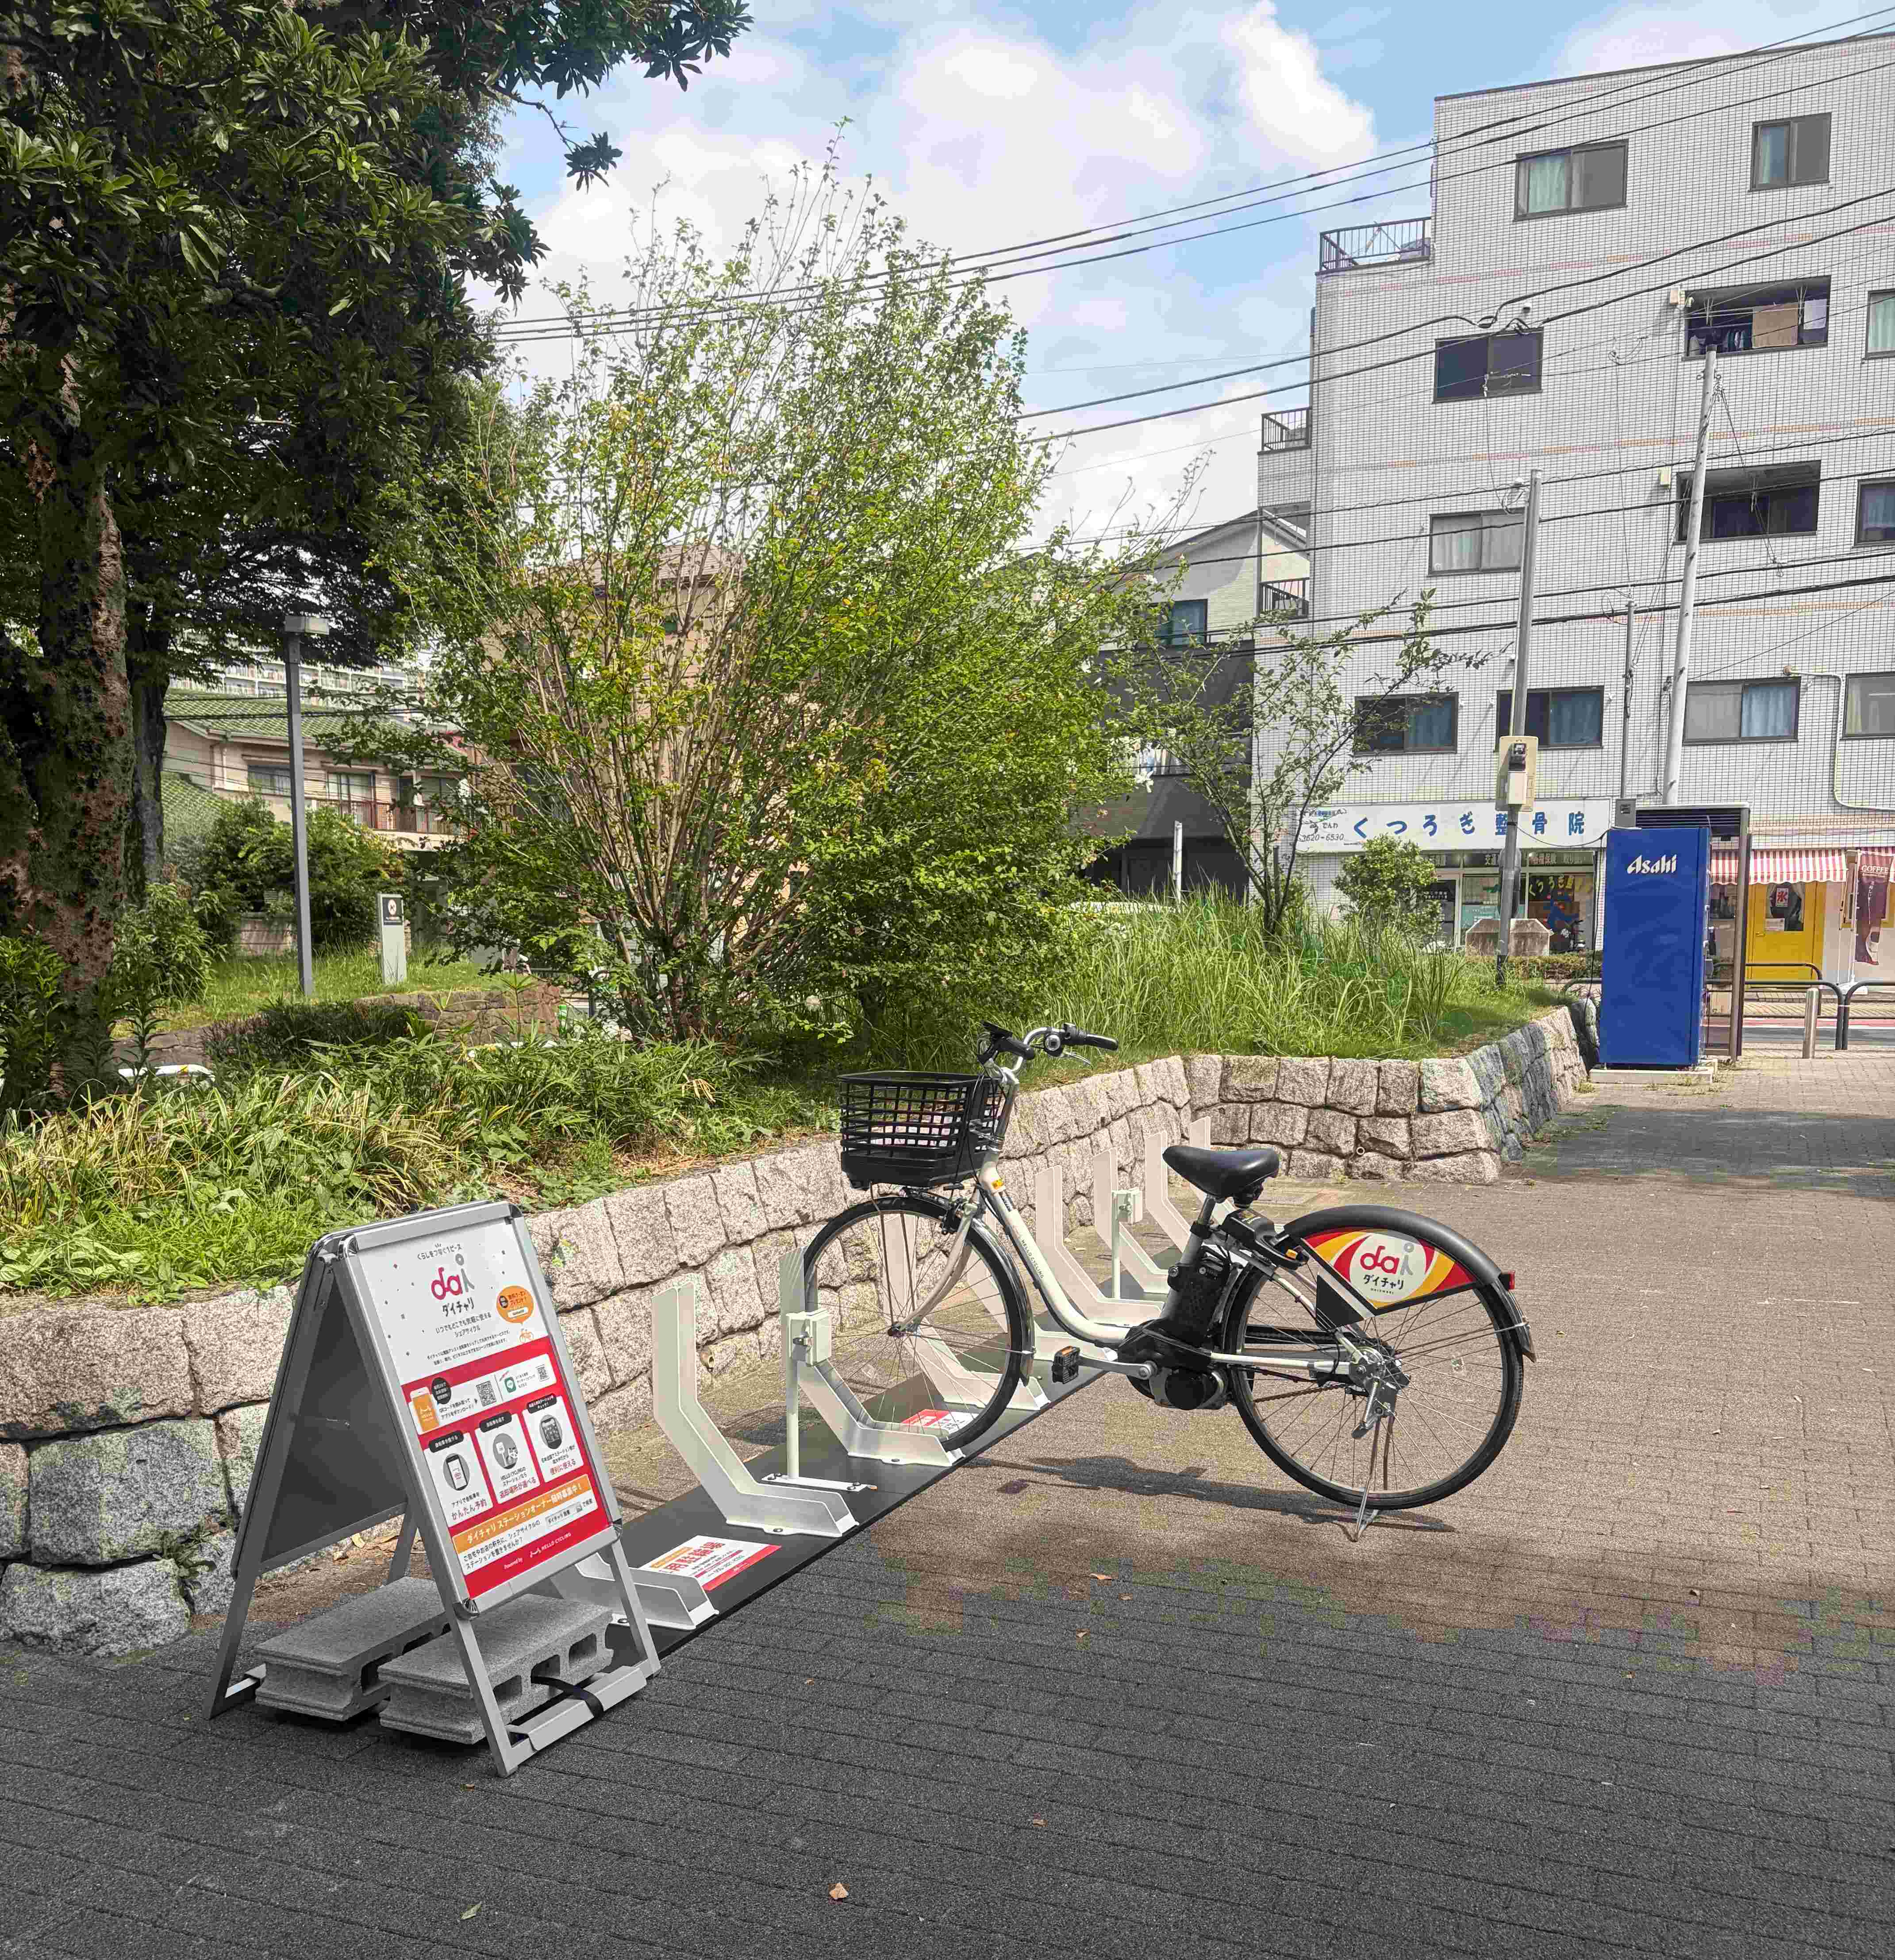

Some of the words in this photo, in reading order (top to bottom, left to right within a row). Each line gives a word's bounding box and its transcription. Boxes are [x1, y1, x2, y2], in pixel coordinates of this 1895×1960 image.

[1627, 855, 1677, 874] Asahi
[1861, 865, 1889, 873] COFFEE
[1363, 1274, 1404, 1290] ダイチャリ
[442, 1297, 474, 1317] ダイチャリ
[454, 1325, 480, 1337] シェアサイクル
[450, 1497, 487, 1521] かんたん予約
[465, 1522, 496, 1544] ダイチャリ
